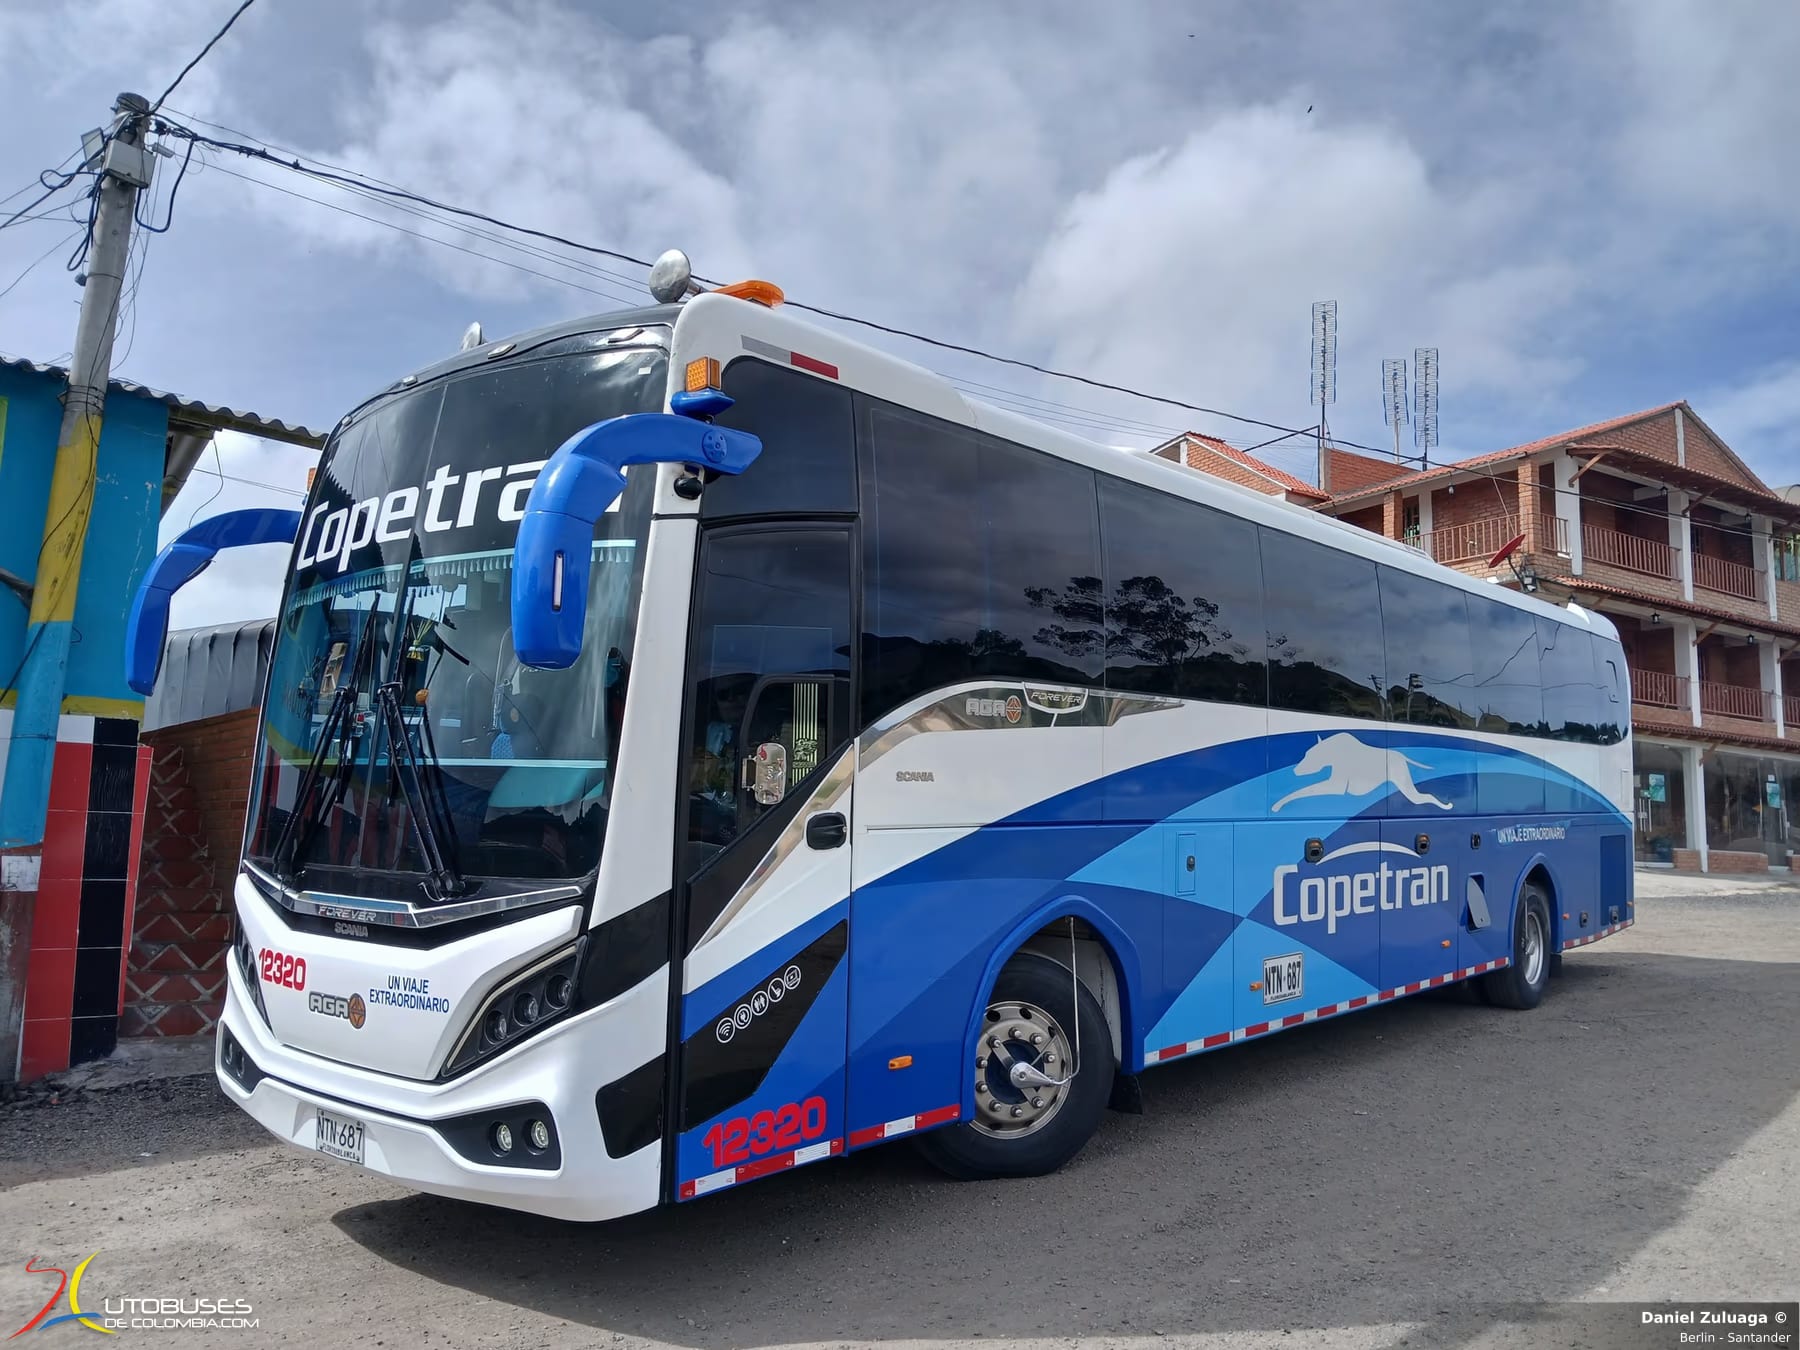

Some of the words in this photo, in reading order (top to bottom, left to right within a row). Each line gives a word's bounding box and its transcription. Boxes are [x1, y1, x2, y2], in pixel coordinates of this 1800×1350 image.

[297, 459, 628, 573] Copetra
[1031, 691, 1081, 704] FOREVER
[896, 771, 935, 783] SCANIA
[1273, 861, 1449, 935] Copetran
[318, 905, 377, 922] FOREVER
[334, 921, 369, 938] SCANIA
[258, 948, 307, 992] 12320
[387, 975, 400, 991] UN
[402, 977, 429, 994] VIAJE
[369, 989, 450, 1014] EXTRAORDINARIO
[703, 1095, 827, 1168] 12320
